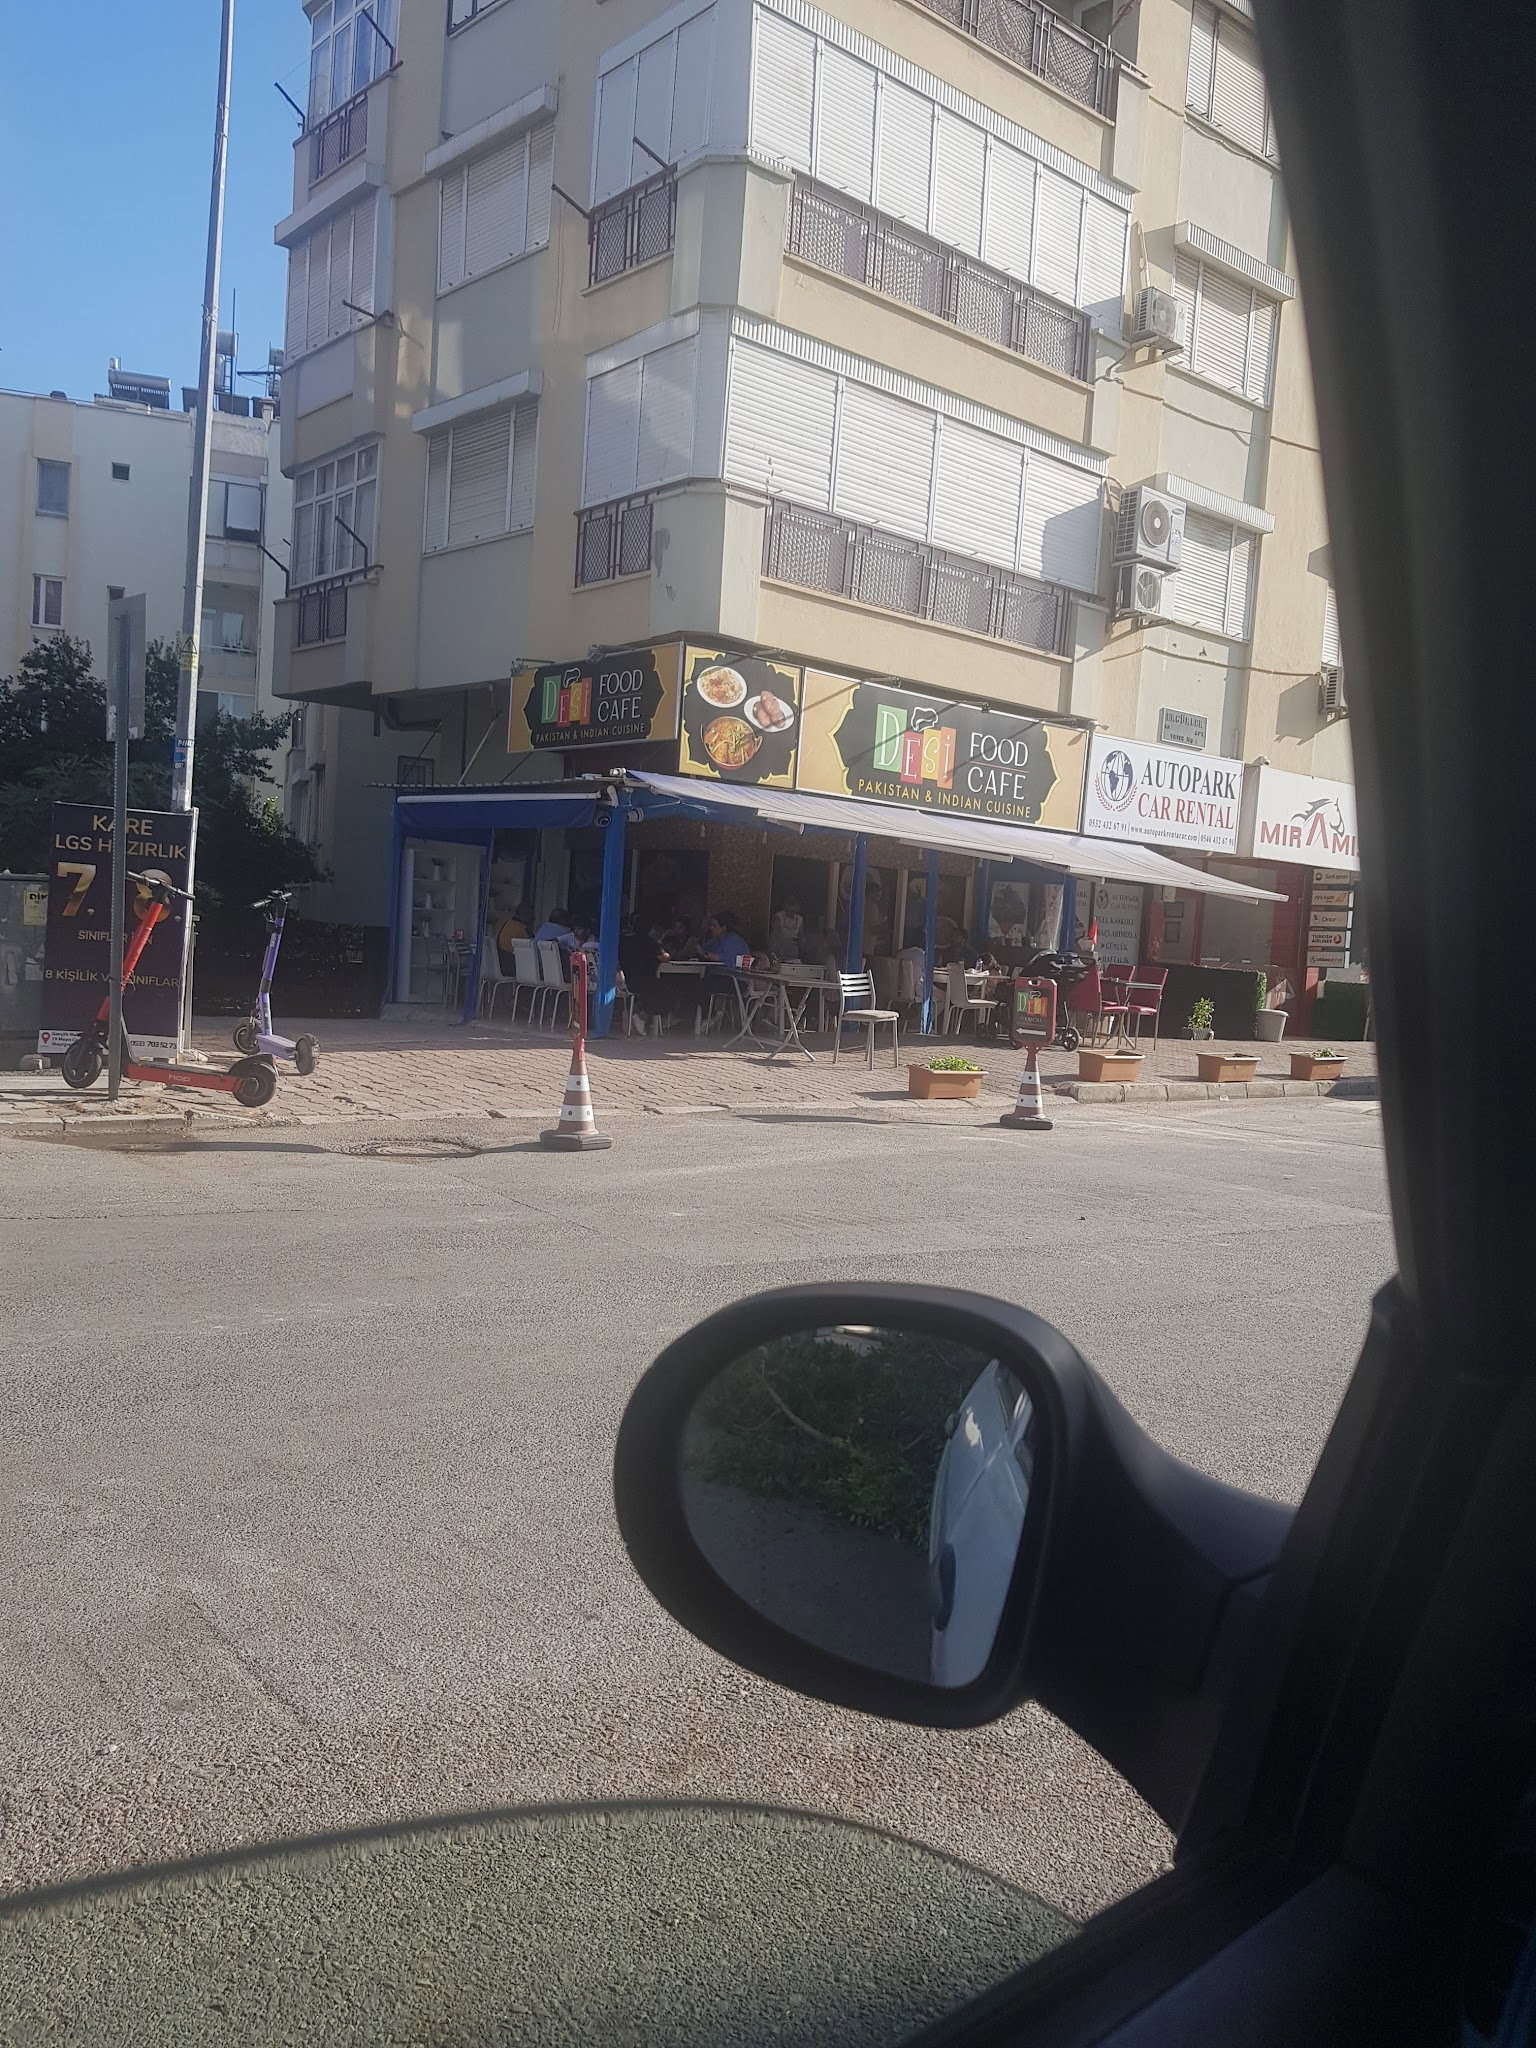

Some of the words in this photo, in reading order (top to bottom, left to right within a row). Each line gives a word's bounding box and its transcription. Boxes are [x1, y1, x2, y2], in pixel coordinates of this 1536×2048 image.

[599, 669, 643, 695] FOOD
[597, 697, 641, 723] CAFE
[536, 731, 570, 742] PAKISTAN
[572, 730, 578, 739] &
[580, 727, 608, 738] INDIAN
[612, 723, 645, 735] CUISINE
[970, 732, 1029, 767] FOOD
[967, 767, 1027, 800] CAFE
[1141, 758, 1237, 800] AUTOPARK
[858, 778, 920, 801] PAKISTAN
[925, 790, 933, 803] &
[938, 791, 981, 810] INDIAN
[986, 800, 1031, 819] CUISINE
[1138, 792, 1174, 821] CAR
[1175, 798, 1235, 830] RENTAL
[1103, 820, 1112, 830] 432
[1260, 812, 1360, 858] MIRAMI
[55, 834, 93, 851] LGS
[98, 838, 187, 859] HZIRLIK
[78, 930, 129, 943] SINIFLR
[45, 969, 53, 979] 8
[168, 1074, 191, 1083] hop
